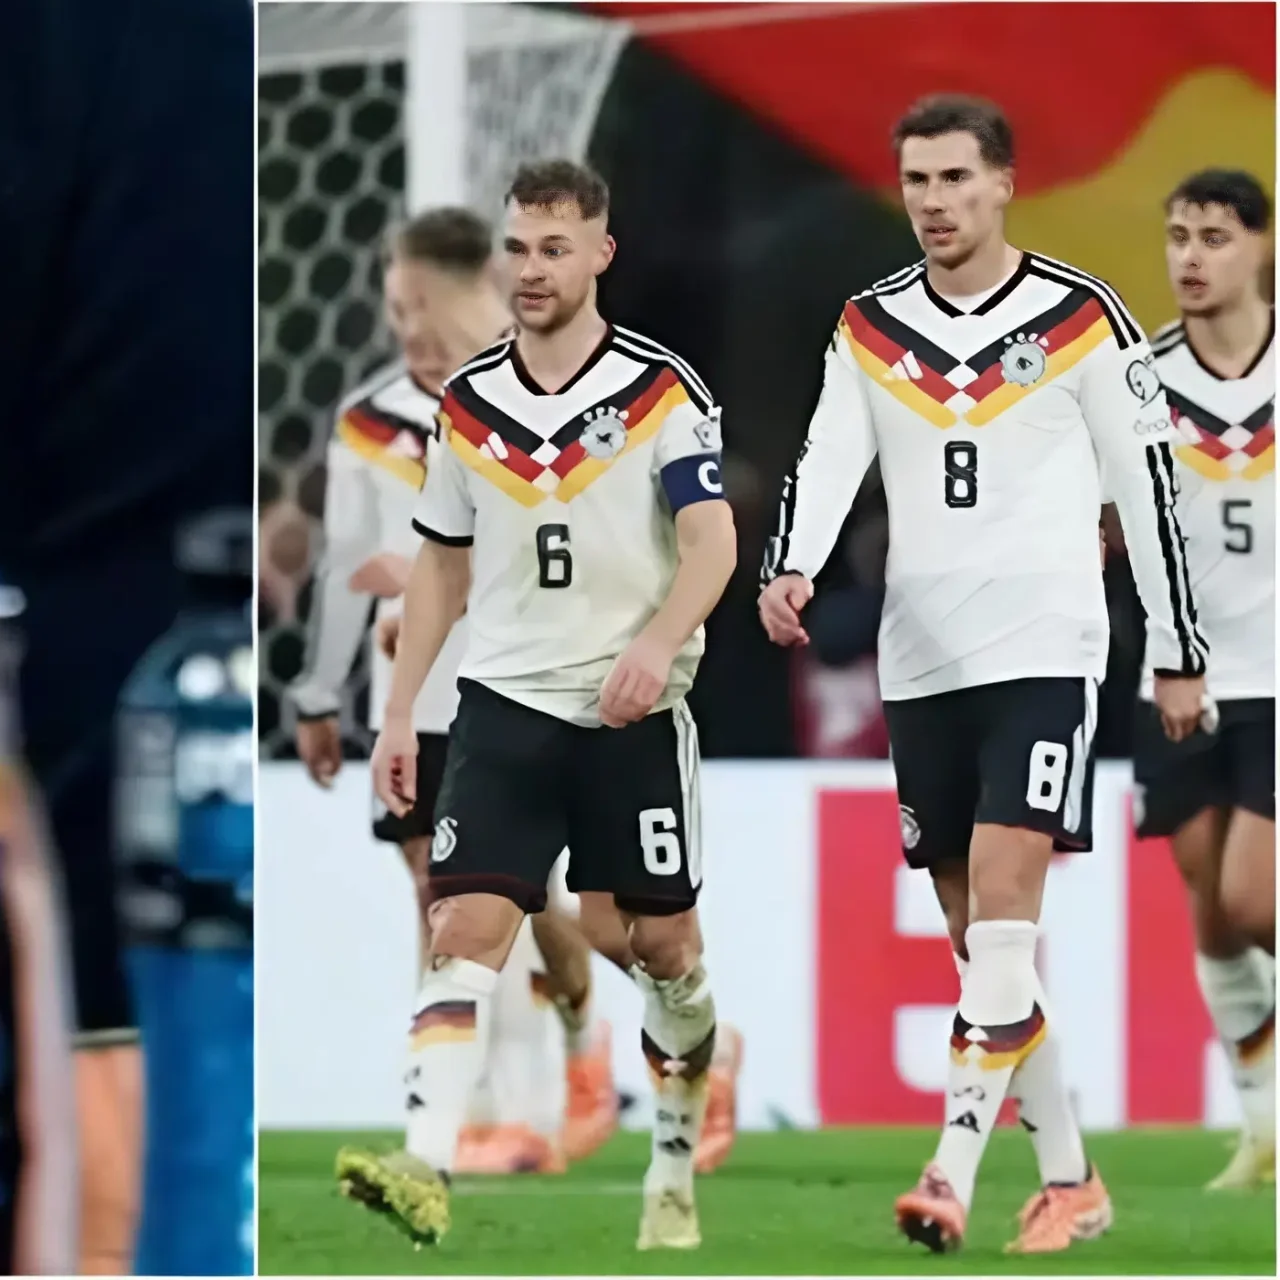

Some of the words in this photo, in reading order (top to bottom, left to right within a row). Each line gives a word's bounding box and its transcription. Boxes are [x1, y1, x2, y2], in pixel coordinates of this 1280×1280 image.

[697, 460, 723, 494] C
[944, 440, 978, 509] 8
[535, 523, 573, 589] 6
[1222, 499, 1254, 554] 5
[1025, 740, 1069, 813] 8
[638, 807, 682, 876] 6
